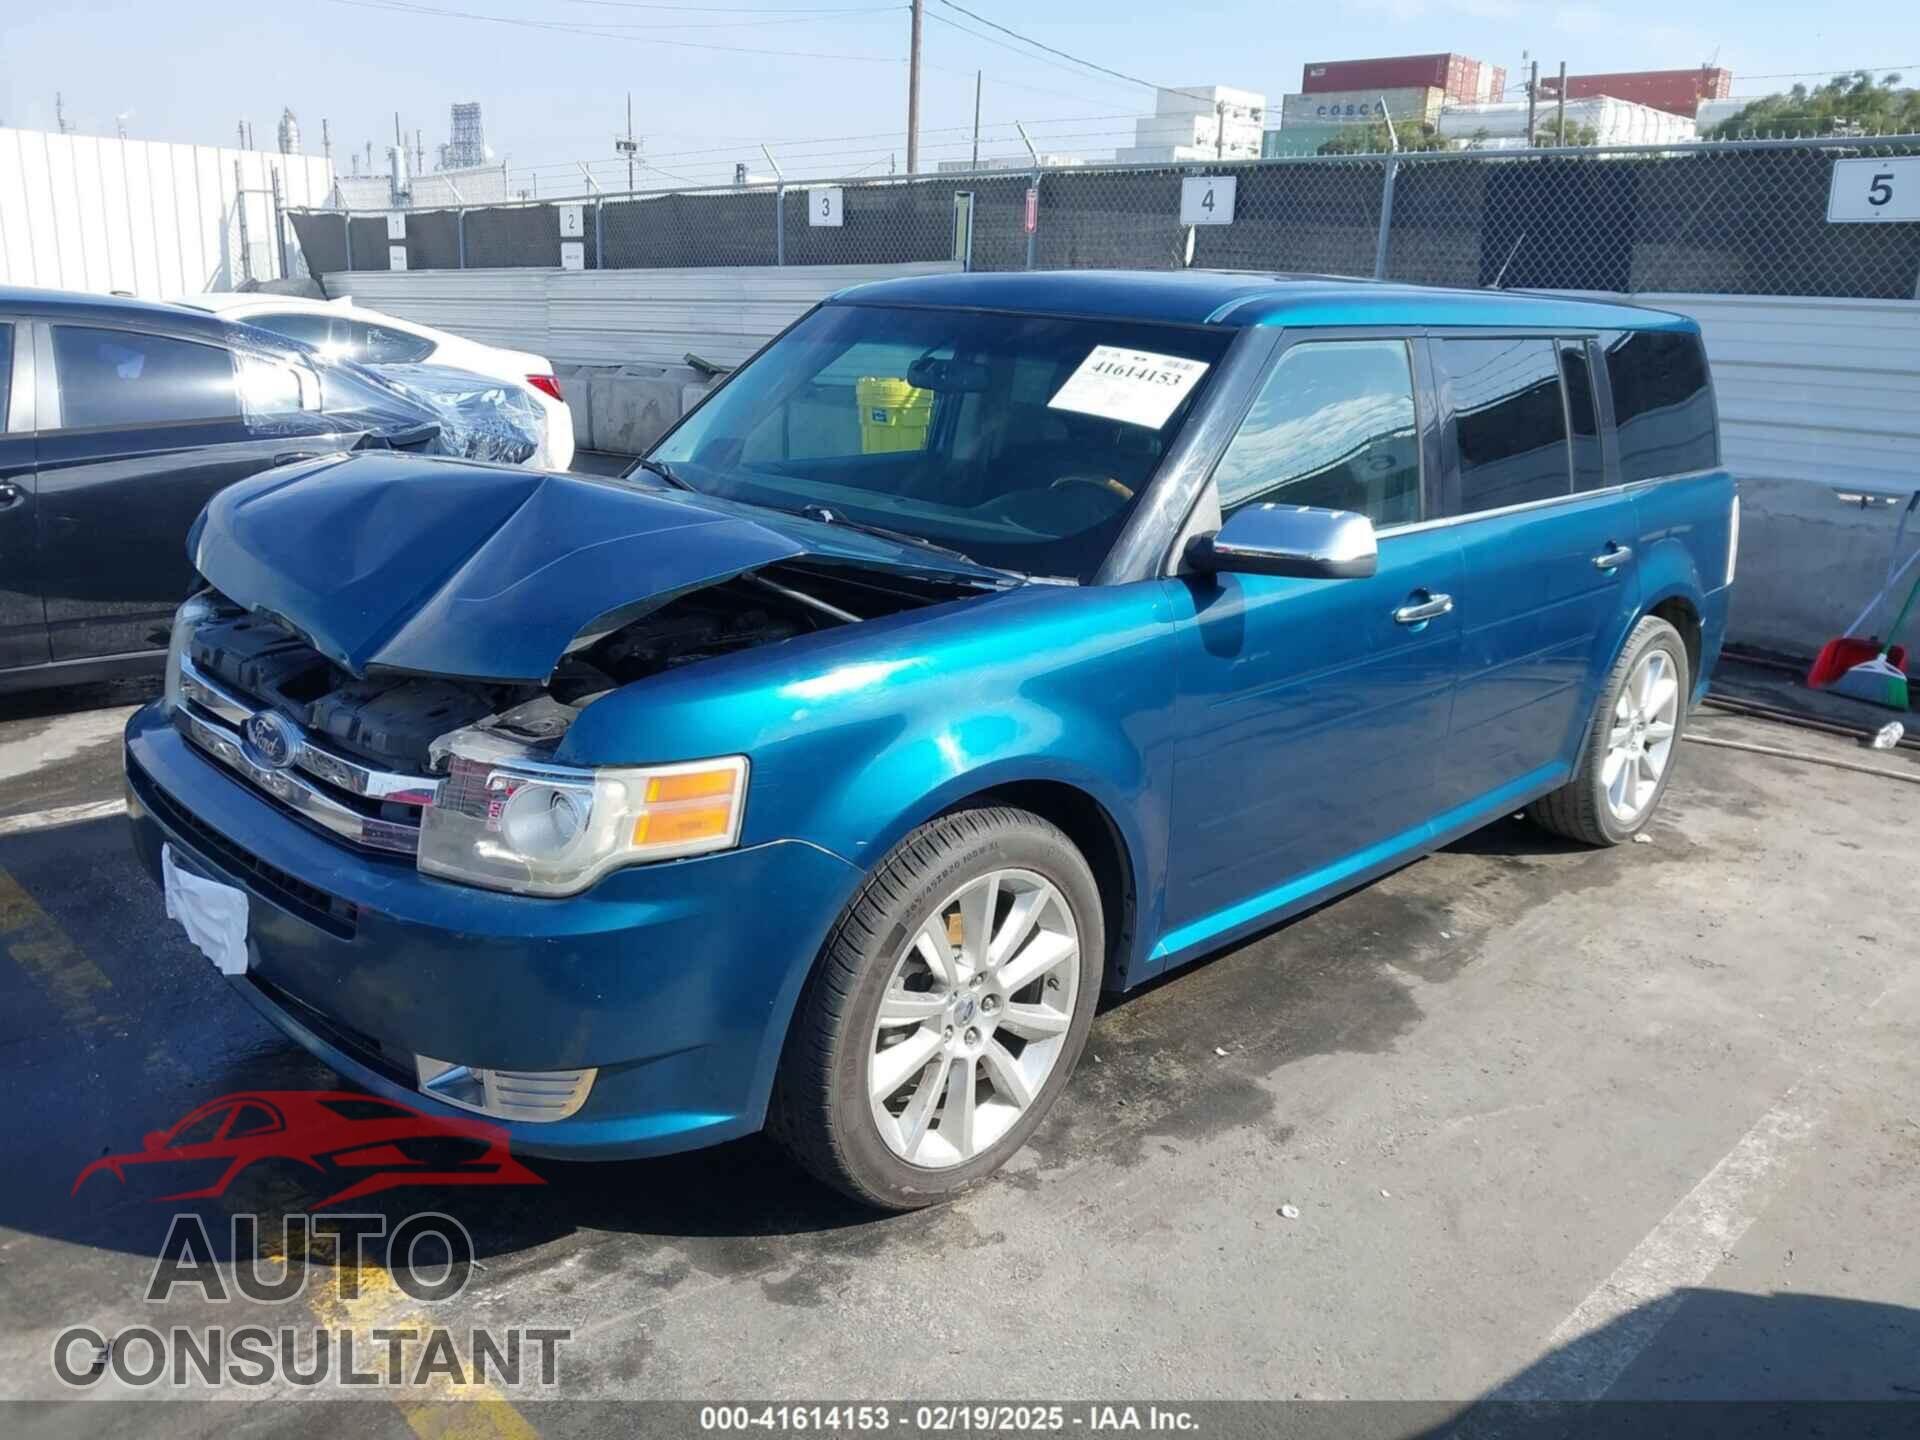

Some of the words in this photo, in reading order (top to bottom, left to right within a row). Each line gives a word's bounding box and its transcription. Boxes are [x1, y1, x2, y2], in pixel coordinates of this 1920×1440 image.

[1201, 189, 1215, 212] 4
[1868, 173, 1895, 206] 5
[822, 197, 830, 217] 3
[568, 214, 575, 230] 2
[1092, 361, 1182, 386] 41614153
[255, 719, 279, 757] Ford
